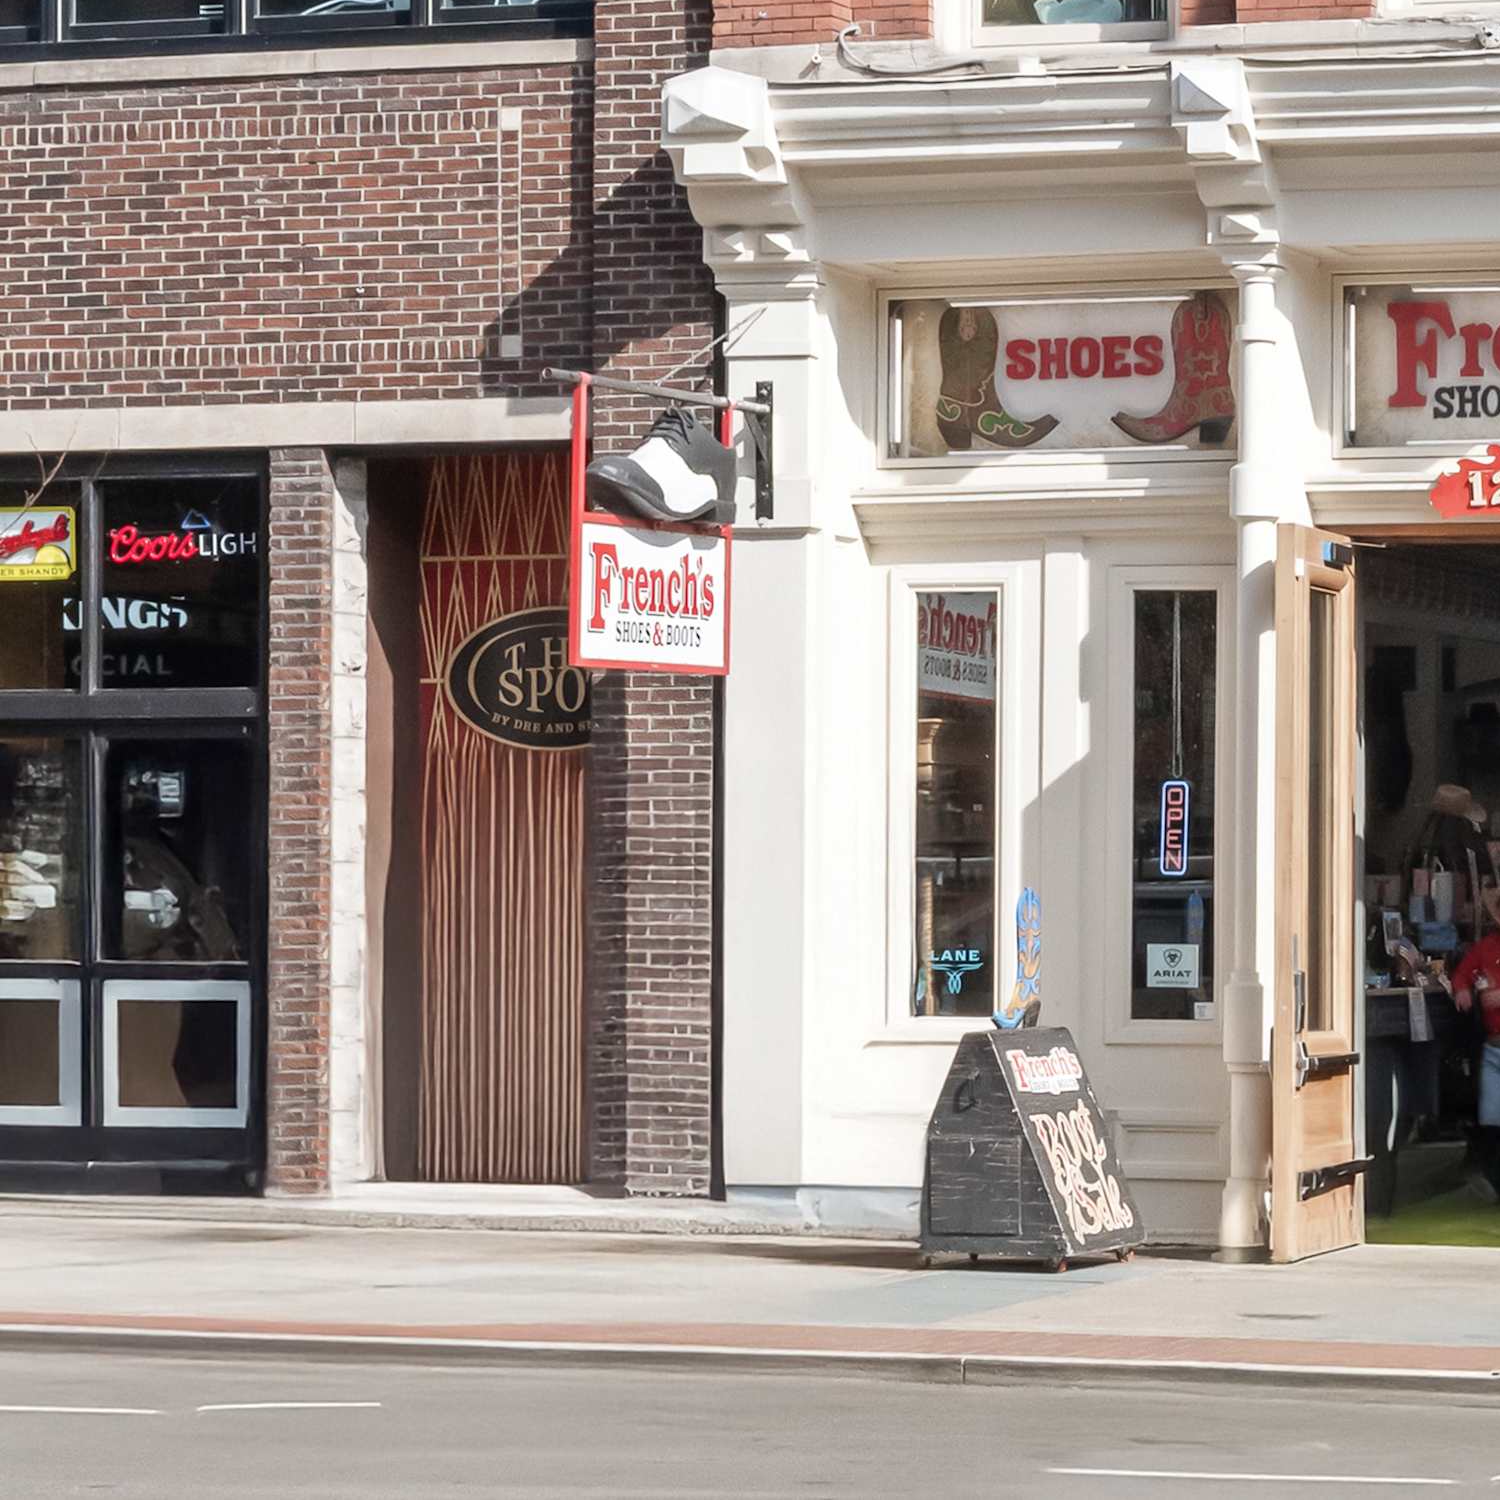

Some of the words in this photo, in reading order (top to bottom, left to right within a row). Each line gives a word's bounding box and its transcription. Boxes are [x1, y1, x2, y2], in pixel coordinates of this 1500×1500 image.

[1005, 334, 1165, 381] SHOES
[110, 523, 200, 563] Coors
[199, 532, 257, 556] LIGH
[19, 567, 65, 576] SHANDY
[588, 542, 715, 632] French's
[616, 620, 650, 643] SHOES
[652, 622, 664, 646] &
[665, 624, 701, 647] BOOTS
[504, 637, 569, 674] TH
[498, 666, 593, 713] SPO
[491, 712, 511, 726] BY
[545, 722, 574, 734] AND
[1166, 787, 1184, 870] OPEN
[929, 949, 980, 962] LANE
[1153, 969, 1193, 978] ARIAT
